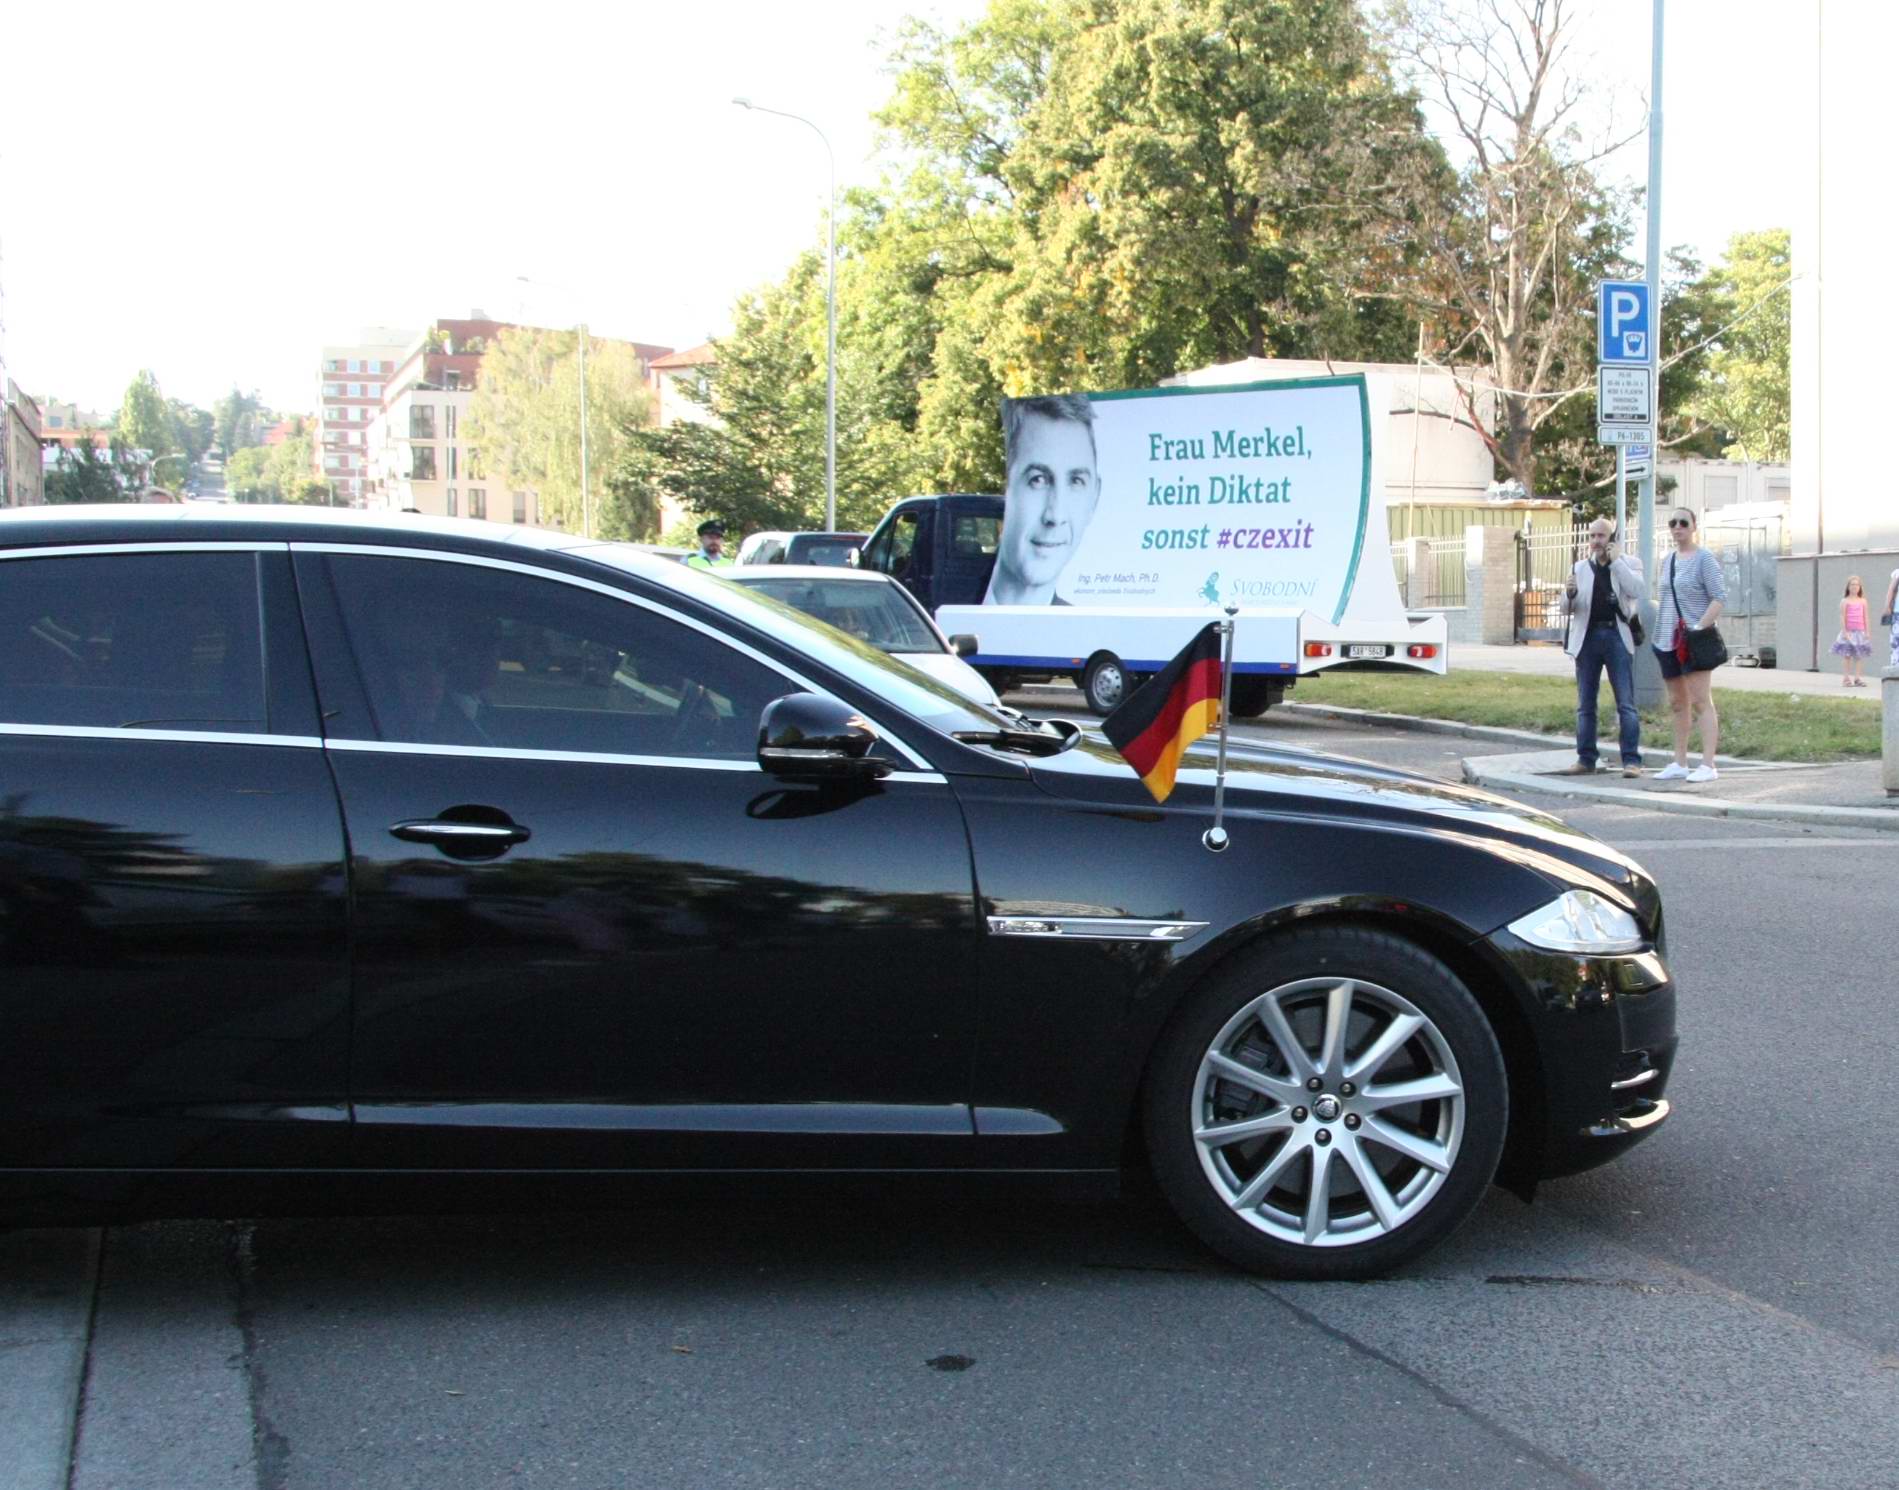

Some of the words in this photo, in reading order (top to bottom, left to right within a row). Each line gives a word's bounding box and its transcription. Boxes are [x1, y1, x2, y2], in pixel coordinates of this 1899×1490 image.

[1610, 291, 1641, 338] P
[1148, 433, 1206, 461] Frau
[1211, 426, 1312, 460] Merkel,
[1147, 475, 1201, 505] kein
[1207, 473, 1292, 504] Diktat
[1141, 523, 1211, 550] sonst
[1216, 518, 1315, 549] #czexit
[1094, 572, 1111, 583] Petr
